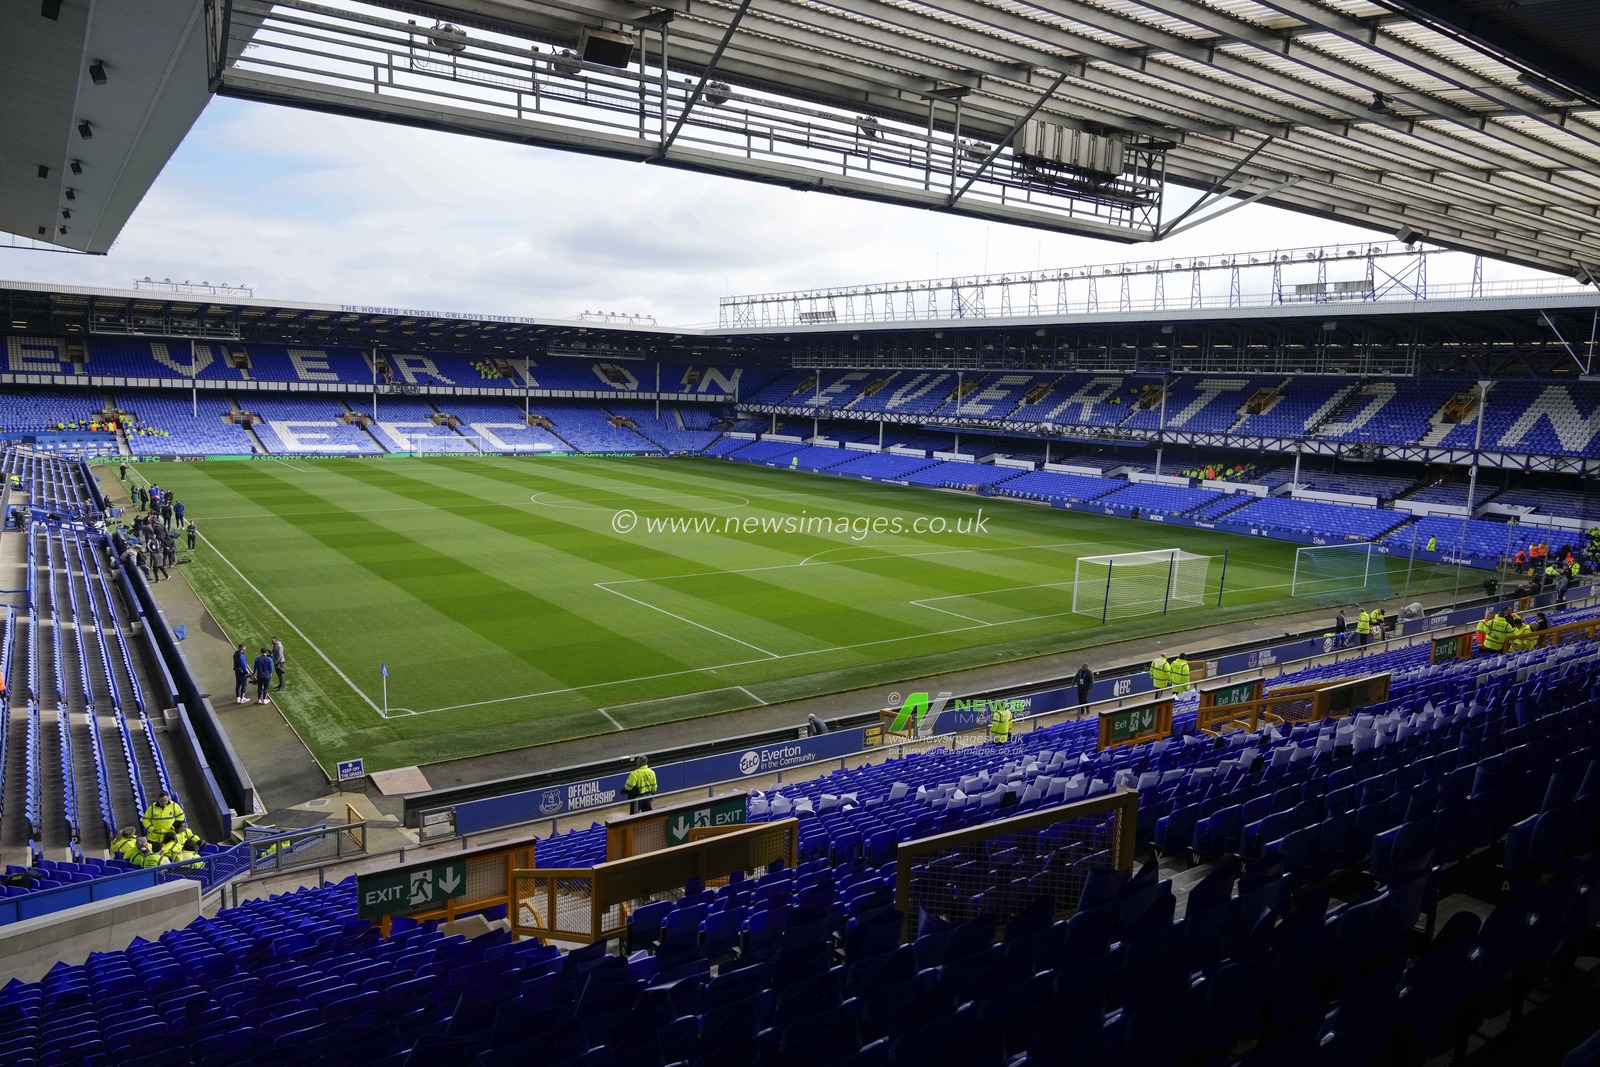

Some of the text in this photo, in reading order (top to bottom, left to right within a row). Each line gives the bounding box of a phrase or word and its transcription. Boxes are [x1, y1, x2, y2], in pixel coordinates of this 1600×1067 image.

[362, 306, 399, 315] HOWARD
[404, 309, 442, 318] KENDALL
[446, 312, 484, 320] GWLADYS
[488, 315, 517, 323] STREET
[268, 420, 554, 452] EFC
[1436, 644, 1448, 656] EXIT
[1120, 680, 1130, 694] EFC
[1218, 696, 1228, 706] Exit
[1115, 720, 1127, 730] Exit
[761, 746, 801, 762] Everton
[780, 753, 816, 766] Community
[568, 781, 600, 798] OFFICIAL
[568, 790, 616, 810] MEMBERSHIP
[716, 809, 742, 824] EXIT
[1154, 849, 1163, 862] V
[1192, 852, 1200, 864] W
[1240, 862, 1247, 873] X
[1500, 879, 1511, 891] A
[366, 885, 404, 906] EXIT
